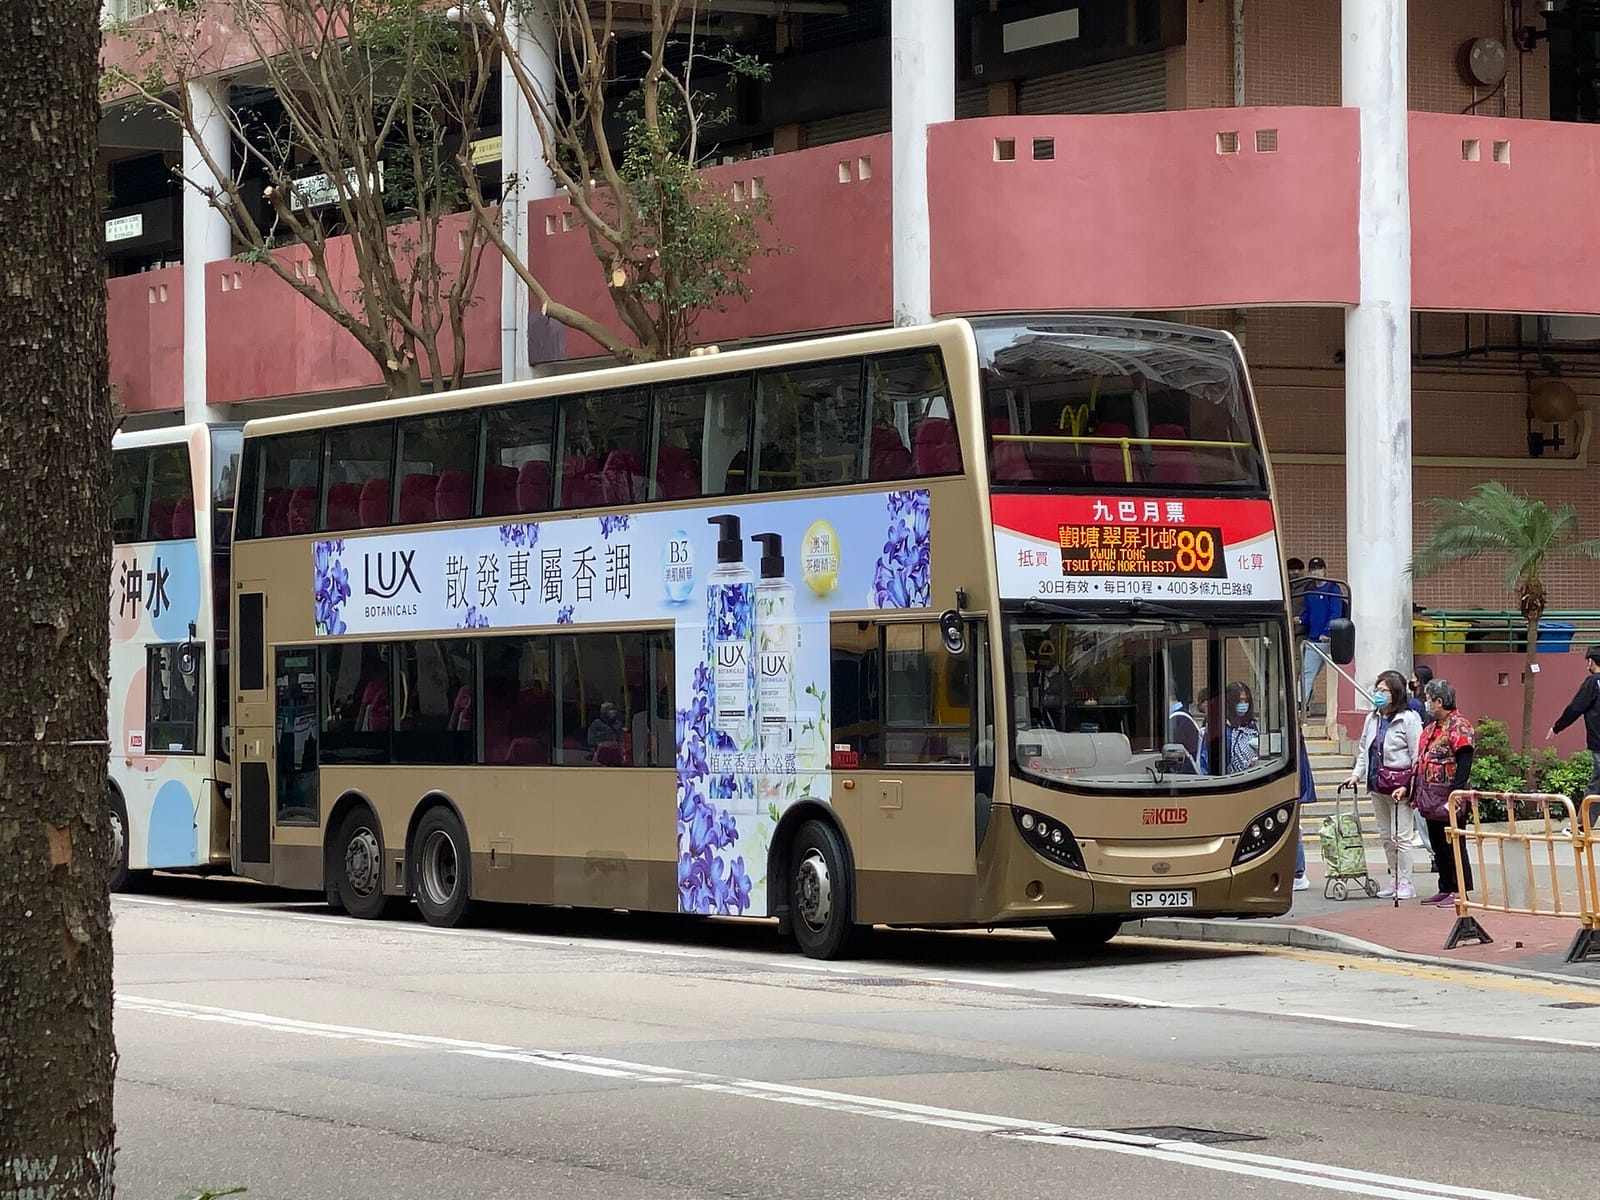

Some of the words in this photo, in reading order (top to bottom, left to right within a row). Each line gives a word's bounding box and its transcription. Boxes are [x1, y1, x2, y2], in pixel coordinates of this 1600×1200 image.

[1093, 500, 1186, 523] 九巴月票
[670, 541, 688, 563] B3
[811, 535, 830, 553] 澳洲
[1176, 530, 1215, 572] 89
[1018, 549, 1048, 567] 抵買
[1090, 549, 1116, 561] KWUN
[1120, 549, 1146, 561] TONG
[1238, 553, 1264, 570] 化算
[665, 566, 693, 582] 美肌精華
[806, 557, 837, 573] 茶樹精油
[1092, 560, 1116, 572] PING
[1118, 560, 1150, 573] NORTH
[364, 550, 422, 599] LUX
[446, 543, 632, 609] 散發專屬香調
[109, 557, 170, 620] 沖水
[1038, 580, 1089, 594] 30日有效
[1103, 580, 1153, 594] 每日10程
[1167, 581, 1253, 596] 400多條九巴路線
[365, 604, 418, 618] BOTANICALS
[718, 646, 746, 667] LUX
[761, 656, 788, 676] LUX
[710, 753, 797, 774] 植萃香氛沐浴露
[1156, 808, 1188, 824] KMB
[1136, 893, 1153, 906] SP
[1159, 892, 1188, 906] 9215
